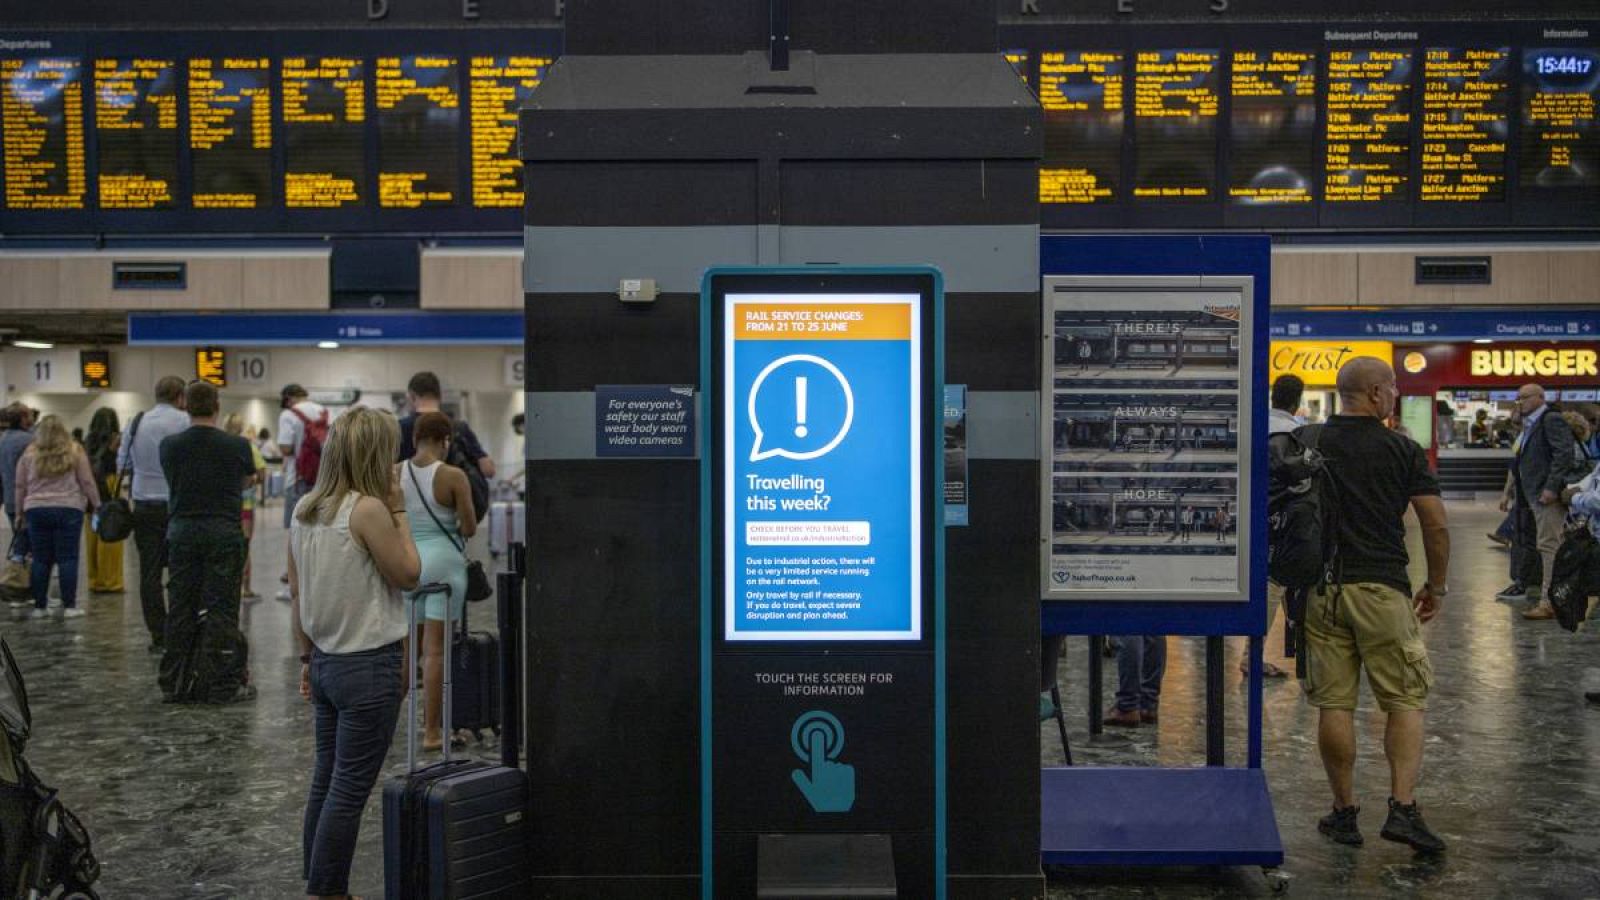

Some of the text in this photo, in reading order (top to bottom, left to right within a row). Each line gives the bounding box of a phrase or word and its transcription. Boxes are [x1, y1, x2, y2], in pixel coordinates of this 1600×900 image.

[1324, 31, 1418, 41] Subsequent Departures
[1543, 29, 1588, 38] Information
[746, 311, 864, 321] RAIL SERVICE CHANGES:
[746, 322, 848, 332] FROM 21 TO 25 JUNE
[1113, 322, 1181, 334] THERE'S
[1376, 323, 1409, 333] Toilets
[1496, 323, 1564, 334] Changing Places
[1273, 346, 1352, 371] Crust
[1471, 350, 1598, 376] BURGER
[34, 361, 51, 381] 11
[240, 359, 265, 379] 10
[608, 399, 682, 412] For everyone's
[1114, 406, 1178, 417] ALWAYS
[606, 411, 640, 423] safety
[660, 411, 687, 423] staff
[604, 423, 687, 435] wear body worn
[608, 435, 683, 445] video cameras
[746, 474, 825, 493] Travelling
[1123, 489, 1168, 499] HOPE
[746, 495, 832, 511] this week?
[746, 557, 875, 566] Due to industrial action, there will
[746, 567, 757, 575] be
[766, 569, 782, 577] very
[783, 567, 810, 575] limited
[839, 567, 870, 577] running
[758, 577, 771, 585] the
[773, 577, 786, 585] rail
[787, 577, 820, 585] network.
[746, 591, 765, 600] Only
[766, 591, 789, 599] travel
[790, 591, 799, 600] by
[801, 591, 814, 599] rail
[815, 591, 822, 600] if
[746, 602, 754, 610] If
[755, 602, 770, 610] you
[771, 602, 781, 610] do
[783, 602, 807, 610] travel,
[808, 602, 834, 610] expect
[746, 611, 849, 619] disruption and plan ahead.
[755, 673, 893, 683] TOUCH THE SCREEN FOR
[783, 685, 865, 696] INFORMATION
